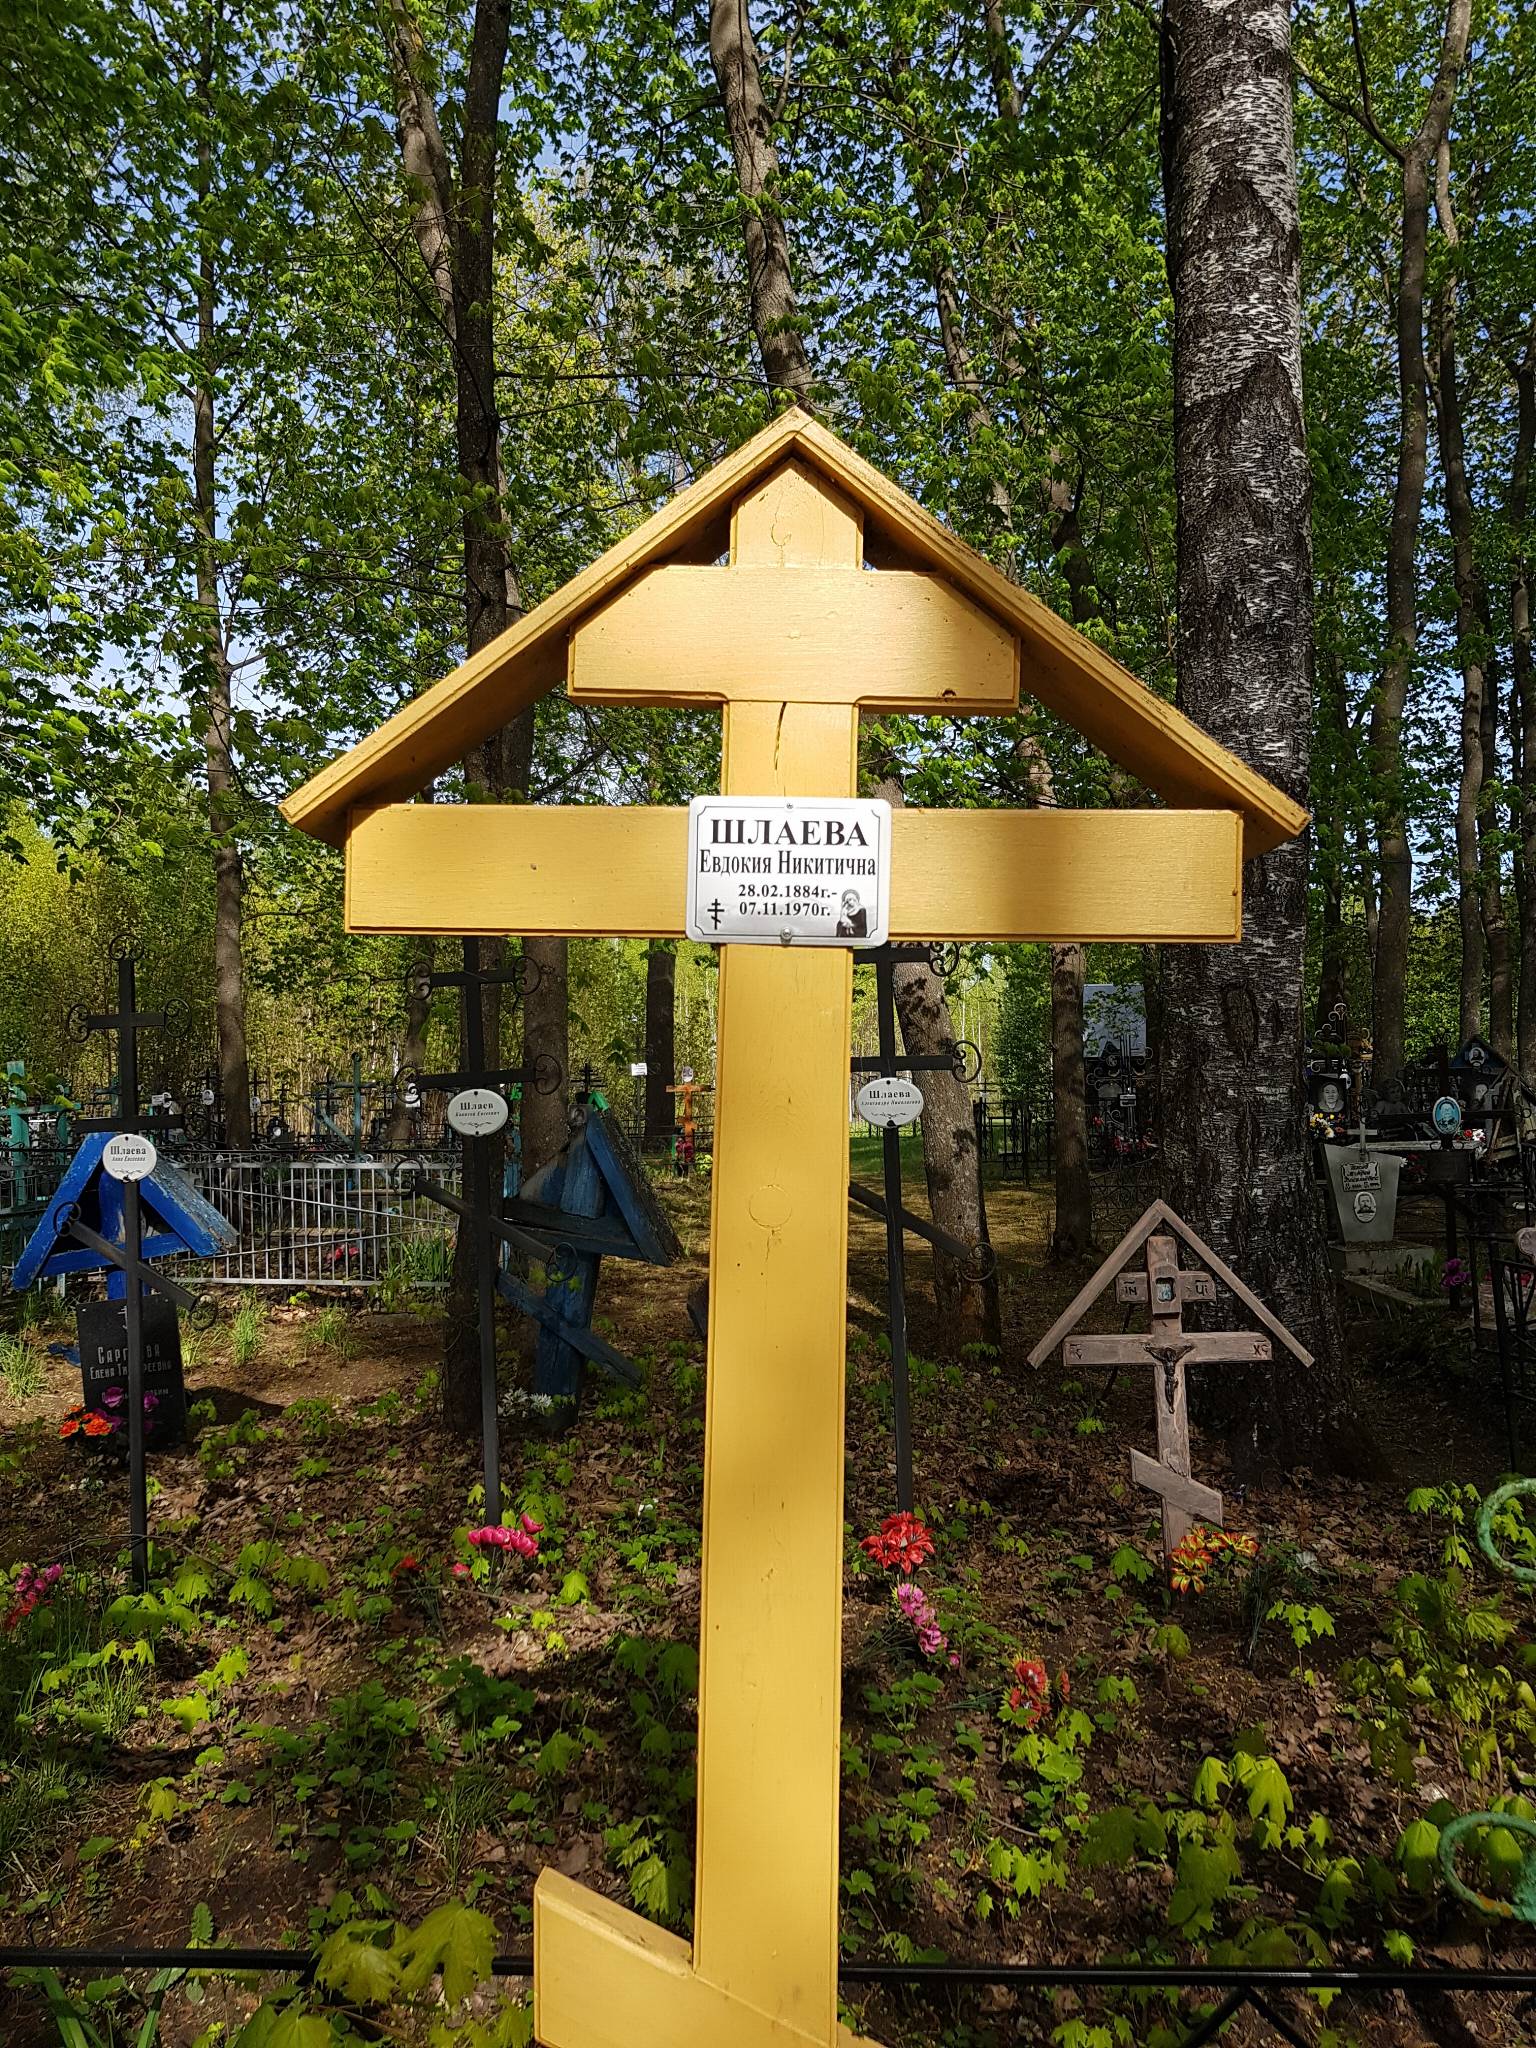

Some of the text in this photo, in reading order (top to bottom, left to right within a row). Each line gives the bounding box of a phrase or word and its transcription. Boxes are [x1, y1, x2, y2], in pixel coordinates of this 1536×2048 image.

[710, 819, 869, 846] ШЛАЕВА
[699, 849, 876, 876] Евдокия Никитична
[739, 902, 831, 916] 07.11.1970г.
[869, 1090, 911, 1099] Шлаева
[460, 1102, 494, 1110] Шлаев
[110, 1145, 147, 1155] Шлаева
